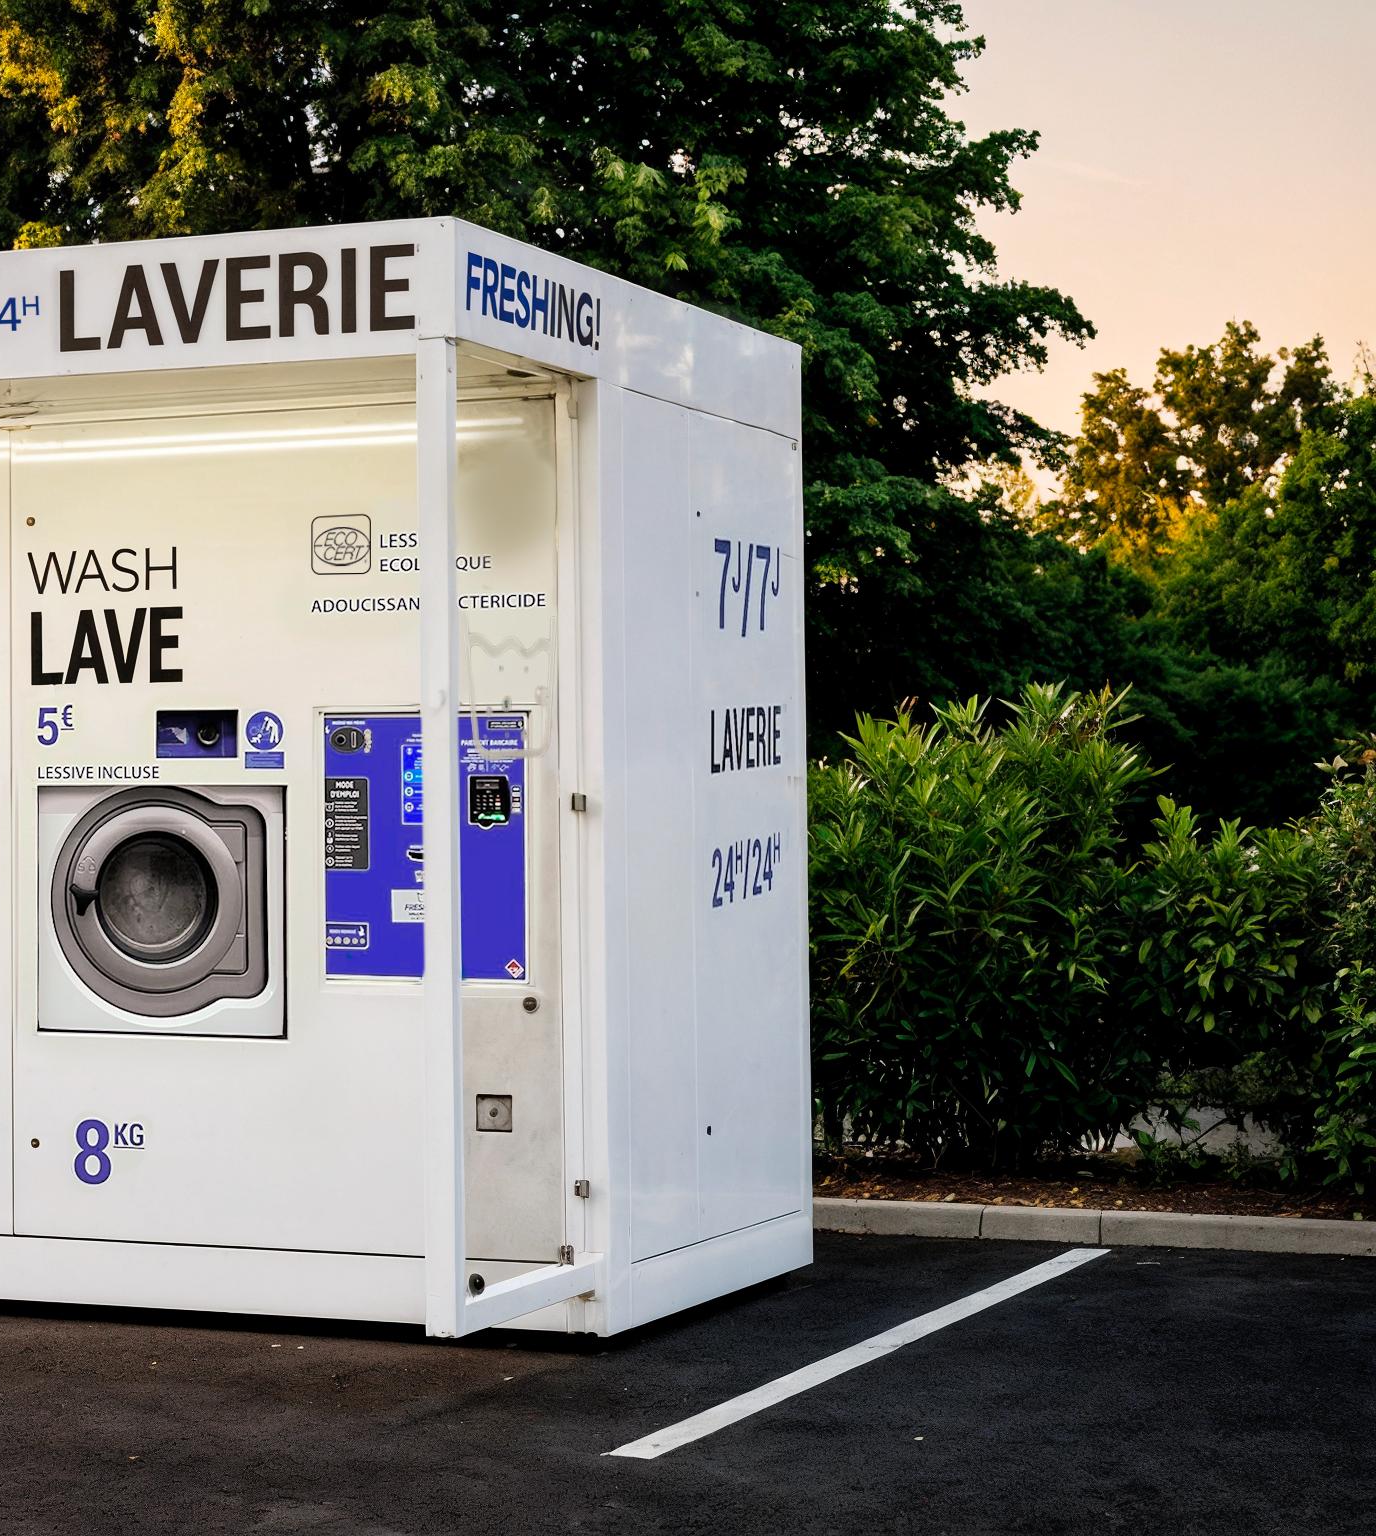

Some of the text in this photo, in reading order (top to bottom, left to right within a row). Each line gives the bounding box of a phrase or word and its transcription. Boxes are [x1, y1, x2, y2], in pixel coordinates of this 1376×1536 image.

[59, 243, 415, 352] LAVERIE
[466, 251, 601, 351] FRESHING!
[324, 531, 359, 547] ECO
[380, 533, 418, 548] LESS
[323, 546, 363, 561] CERT
[28, 546, 177, 594] WASH
[380, 556, 492, 572] ECOLQUE
[311, 593, 546, 612] ADOUCISSAN CTERICIDE
[31, 606, 183, 685] LAVE
[37, 704, 74, 746] 5€
[710, 705, 782, 774] LAVERIE
[37, 765, 160, 779] LESSIVE INCLUSE
[335, 781, 355, 789] MODE
